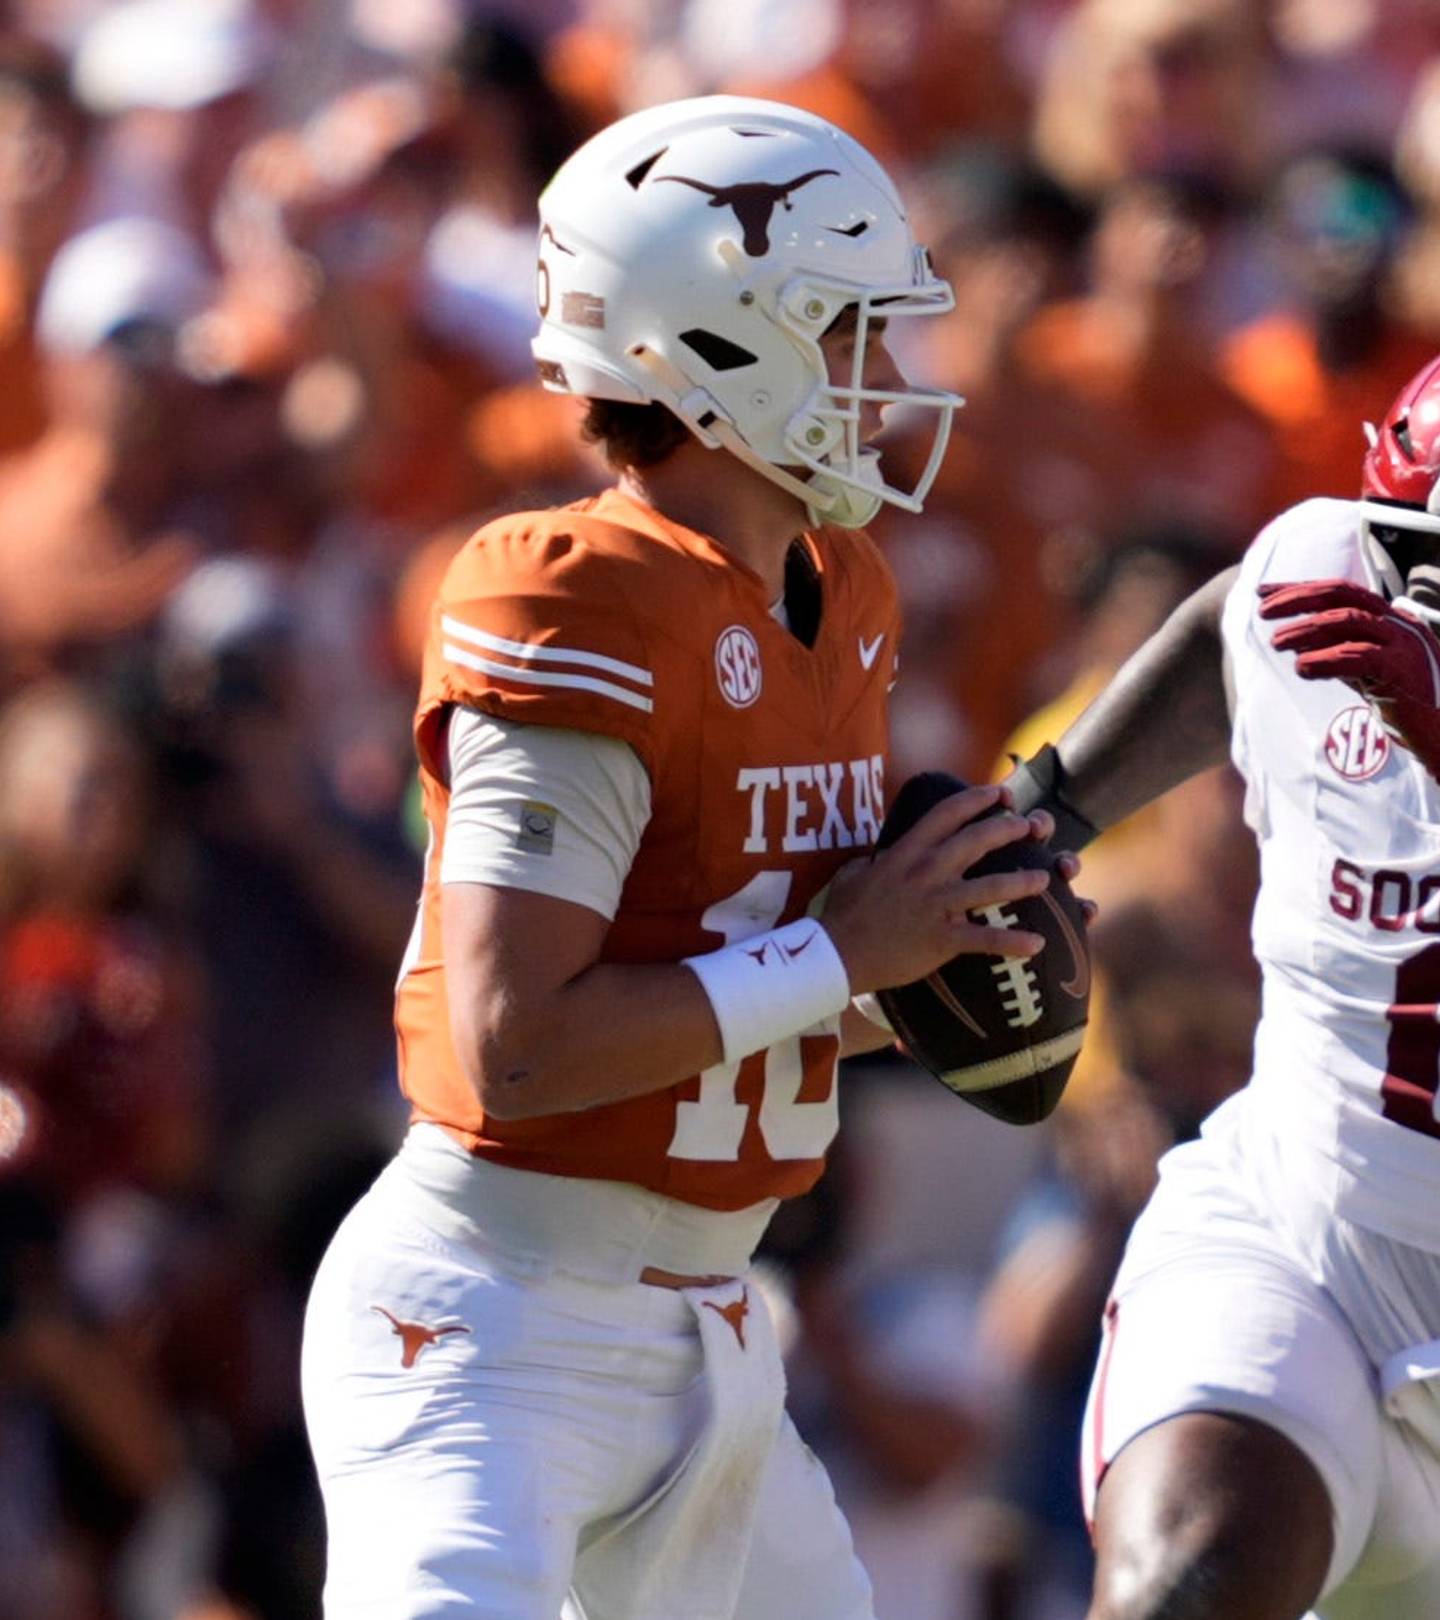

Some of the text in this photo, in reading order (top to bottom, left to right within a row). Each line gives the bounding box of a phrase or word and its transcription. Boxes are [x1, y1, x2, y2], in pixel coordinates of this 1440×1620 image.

[718, 629, 760, 703] SEC
[1325, 706, 1386, 778] SEC
[737, 754, 885, 853] TEXAS
